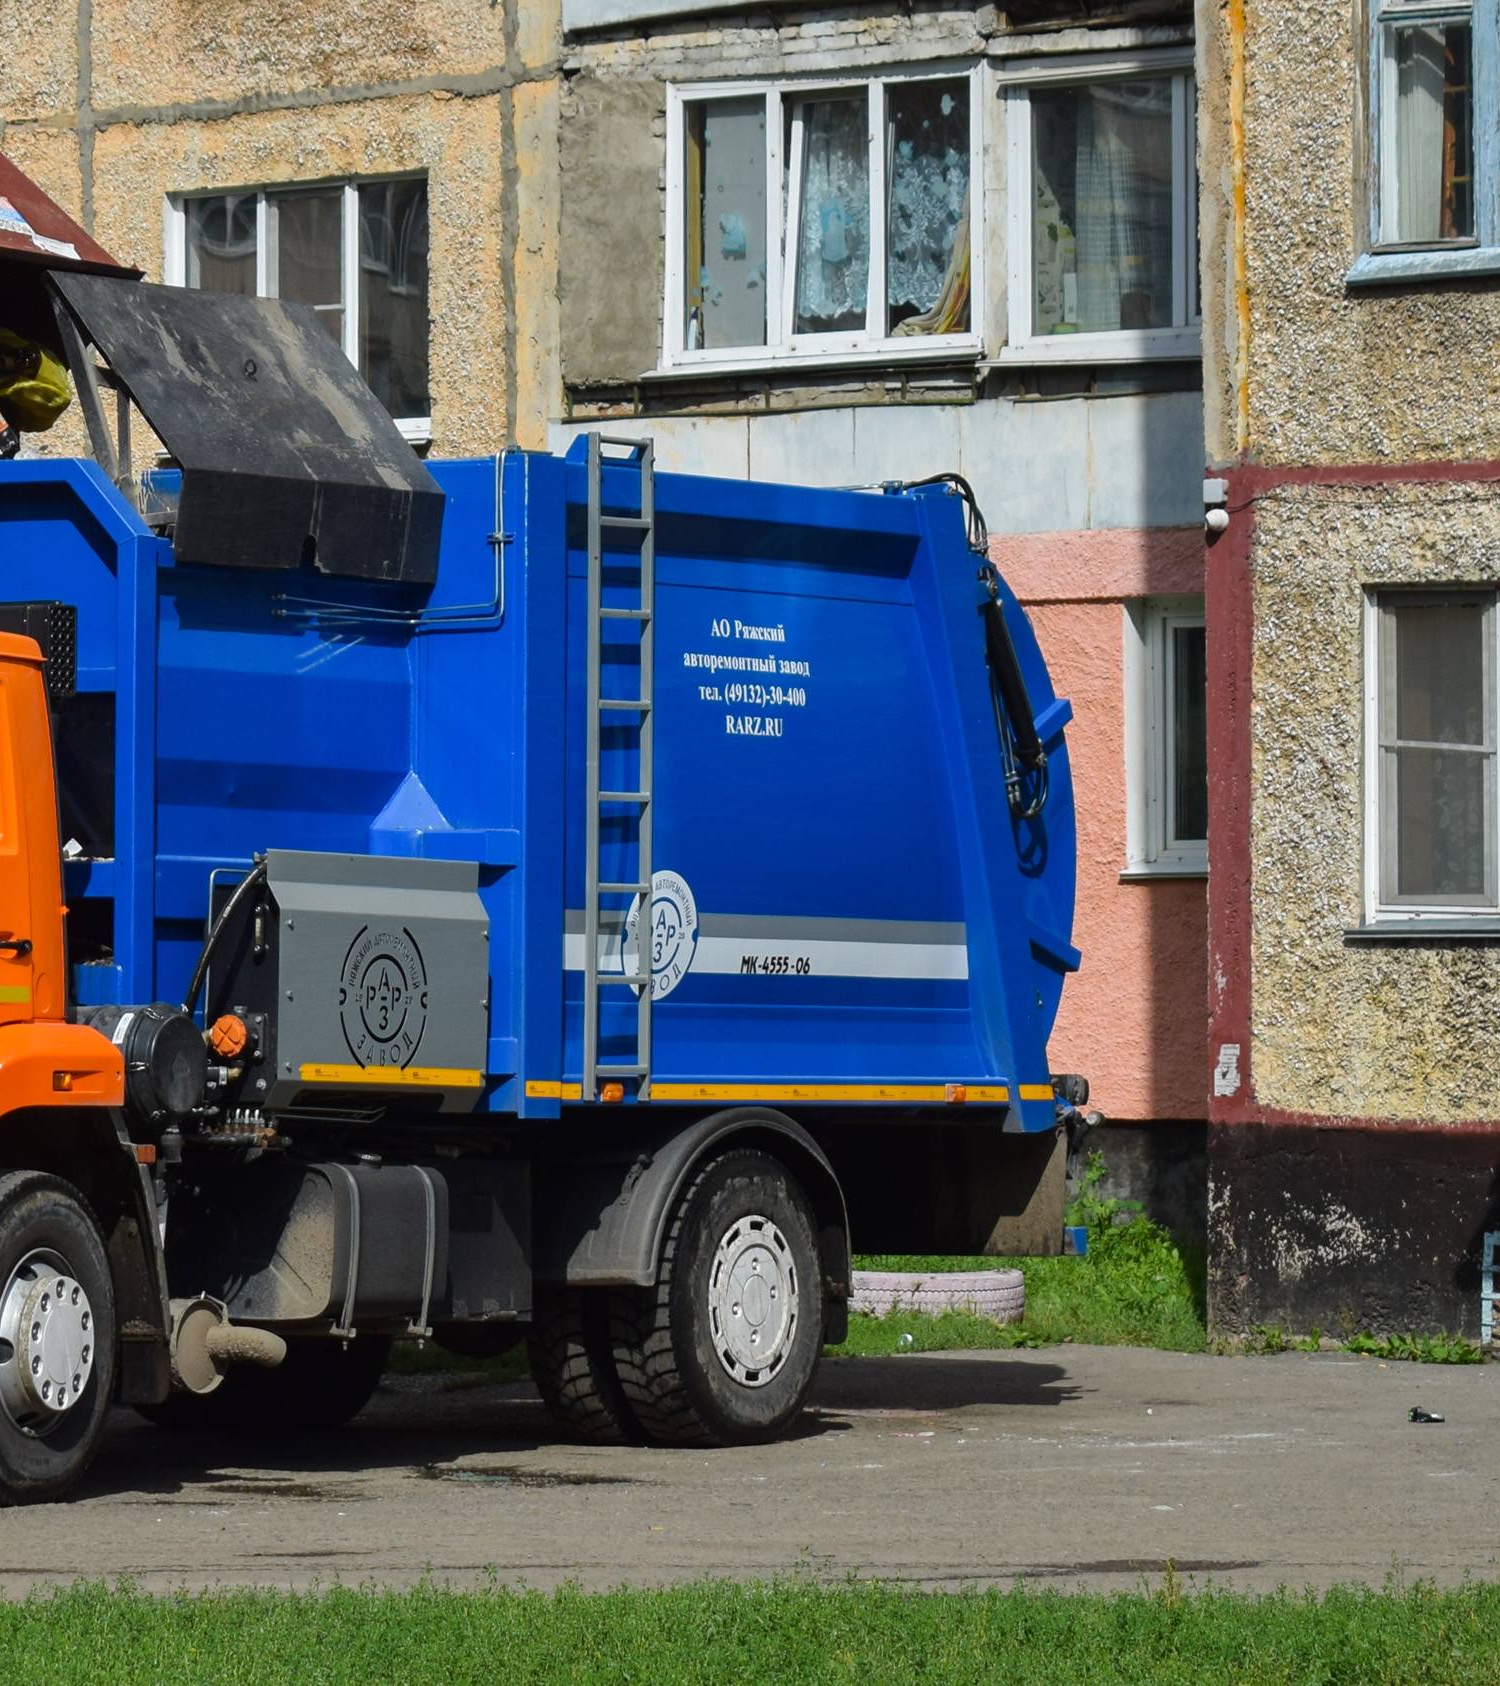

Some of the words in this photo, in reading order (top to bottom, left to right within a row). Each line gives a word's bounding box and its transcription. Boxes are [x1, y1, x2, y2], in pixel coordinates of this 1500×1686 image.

[711, 618, 731, 638] АО
[734, 619, 786, 642] Ряжский
[683, 652, 777, 674] авторемонтный
[778, 660, 810, 677] завод
[698, 686, 722, 701] тел.
[724, 682, 806, 708] (49132)-30-400
[725, 714, 784, 737] RARZ.RU
